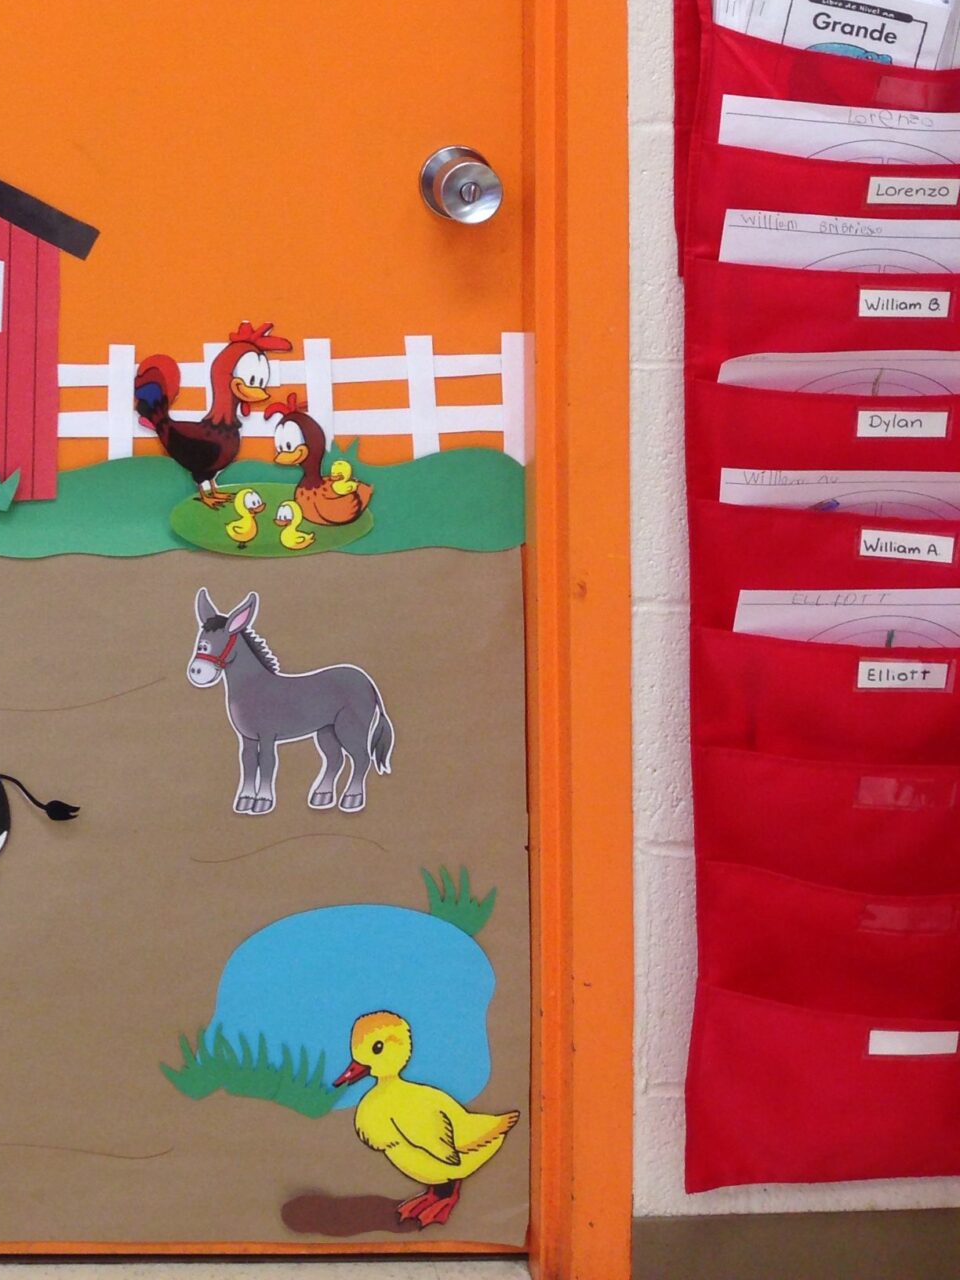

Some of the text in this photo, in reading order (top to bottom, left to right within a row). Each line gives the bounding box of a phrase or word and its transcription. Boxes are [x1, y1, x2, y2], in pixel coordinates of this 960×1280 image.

[812, 11, 898, 45] Grande
[875, 183, 951, 198] Lorenzo
[864, 296, 923, 312] William
[868, 413, 924, 433] Dylan
[863, 536, 922, 555] William
[867, 667, 932, 683] Elliott
